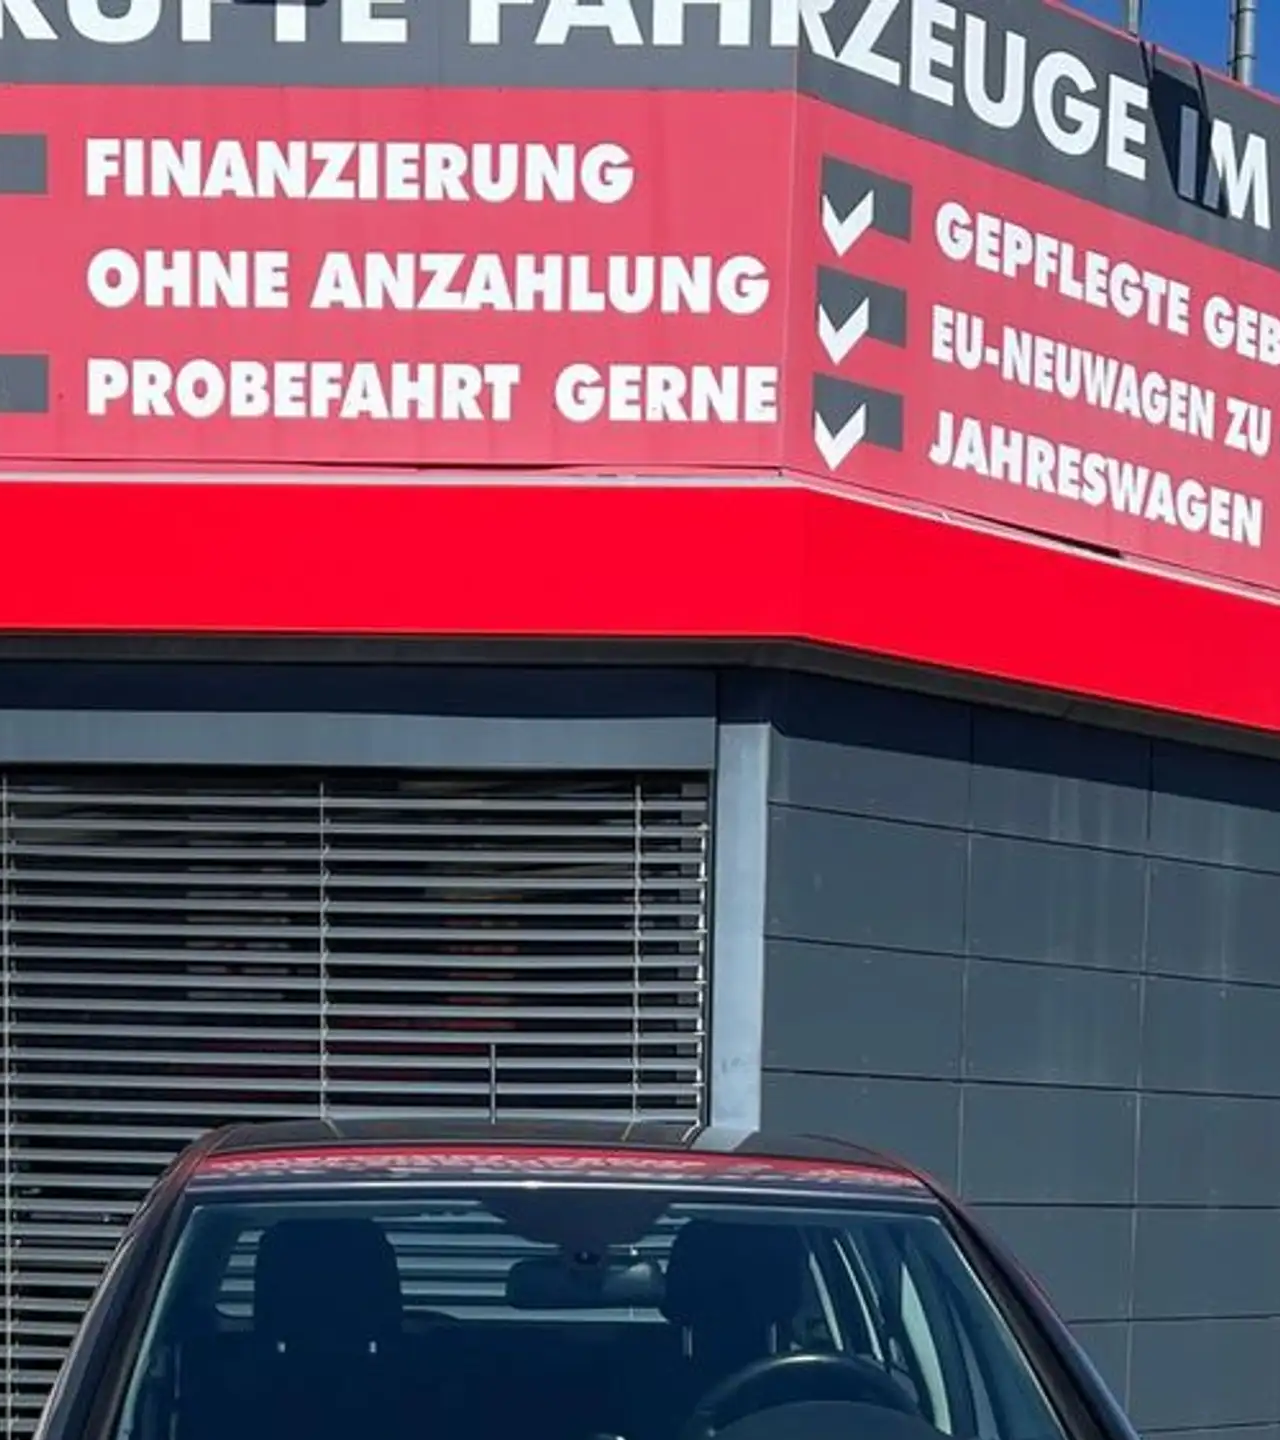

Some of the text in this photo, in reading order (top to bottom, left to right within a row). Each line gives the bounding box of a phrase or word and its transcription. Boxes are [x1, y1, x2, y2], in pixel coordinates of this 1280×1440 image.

[85, 137, 634, 203] FINANZIERUNG
[1178, 105, 1271, 230] IM
[86, 250, 770, 316] OHNE ANZAHLUNG
[934, 201, 1190, 336] GEPFLEGTE
[86, 357, 779, 424] PROBEFAHRT GERNE
[930, 304, 1215, 442] EU-NEUWAGEN
[1224, 397, 1272, 457] ZU
[929, 411, 1263, 547] JAHRESWAGEN
